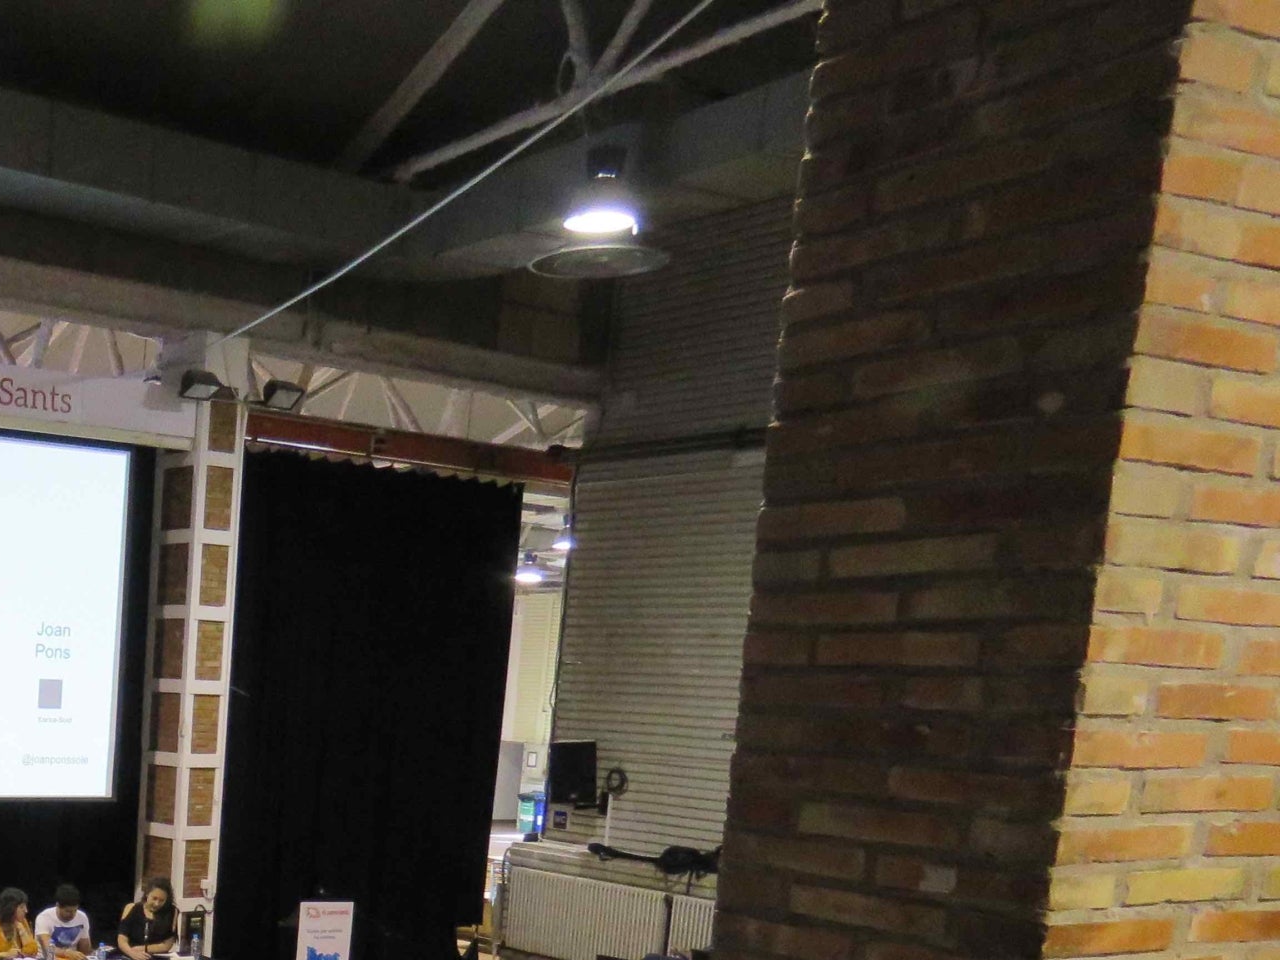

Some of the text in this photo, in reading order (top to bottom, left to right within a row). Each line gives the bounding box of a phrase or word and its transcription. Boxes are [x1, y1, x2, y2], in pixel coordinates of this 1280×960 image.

[0, 376, 73, 414] Sants
[36, 621, 71, 637] Joan
[35, 643, 71, 660] Pons
